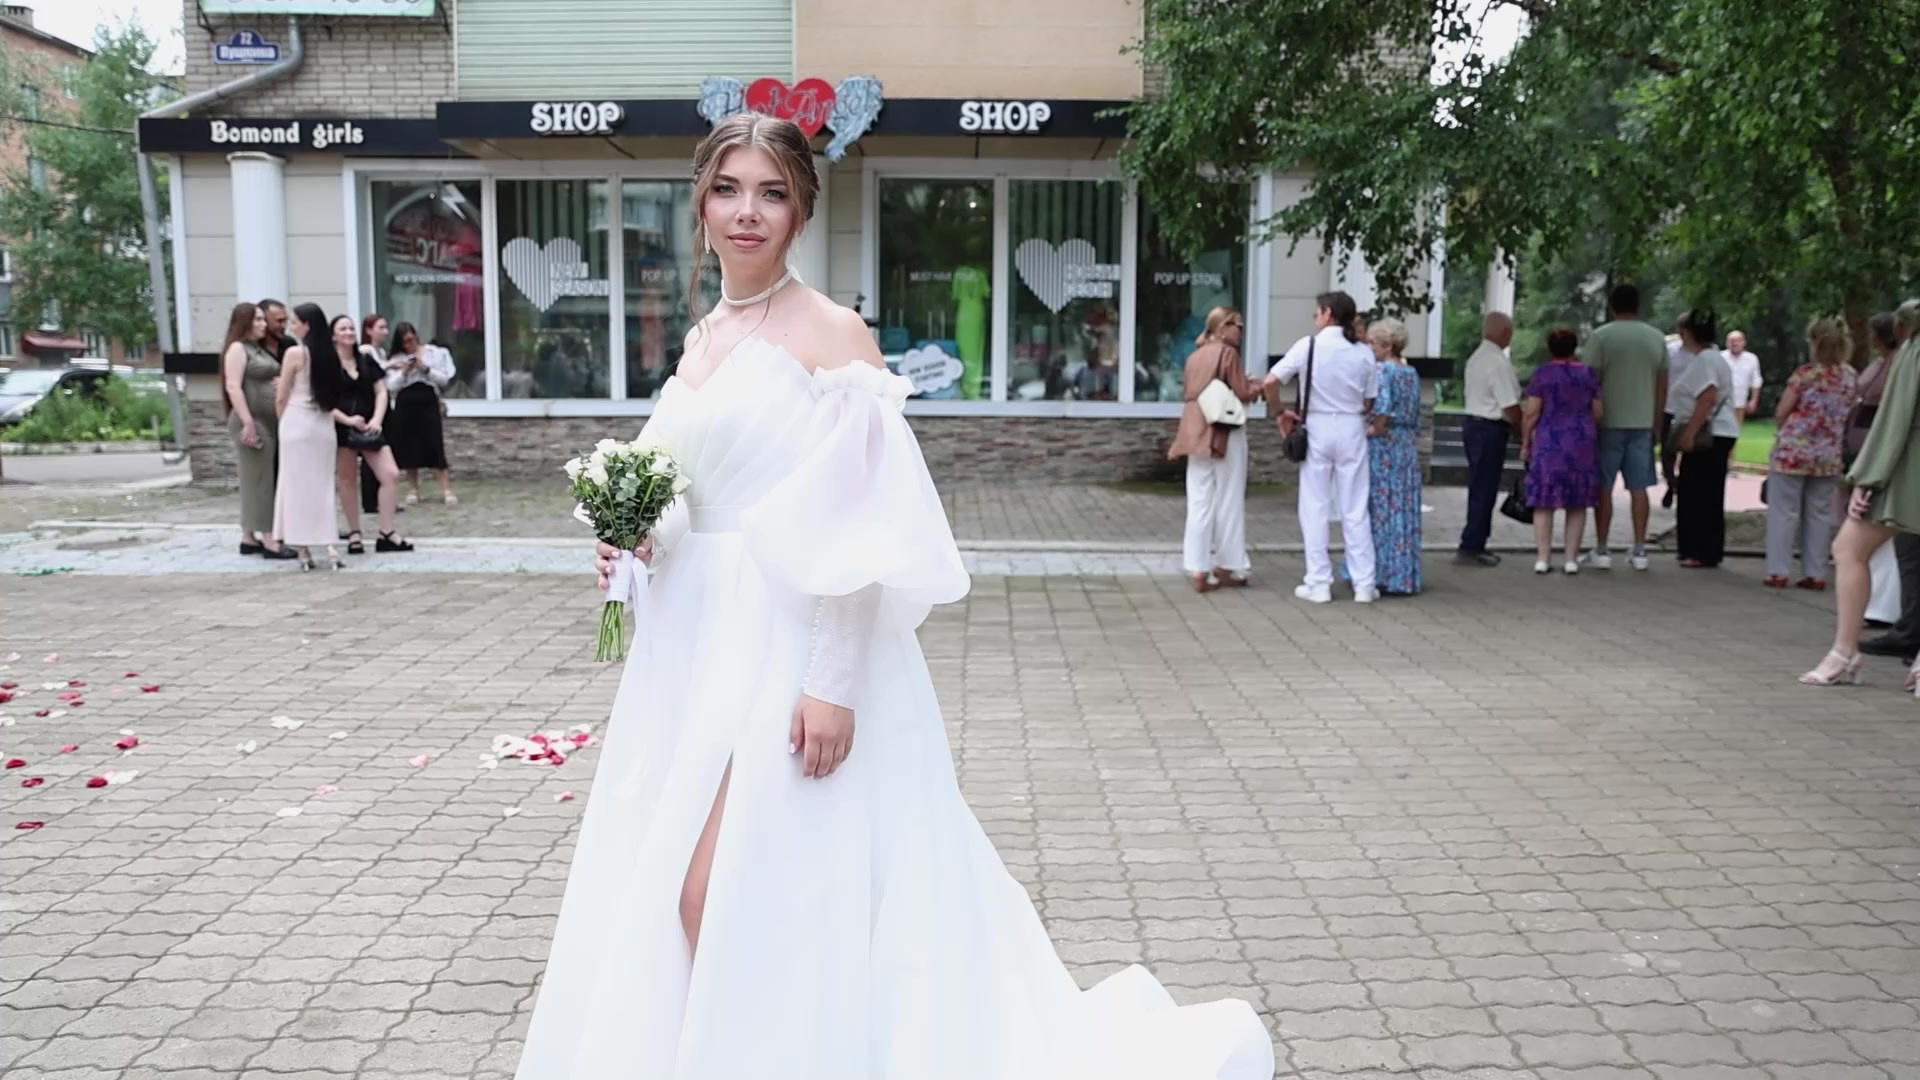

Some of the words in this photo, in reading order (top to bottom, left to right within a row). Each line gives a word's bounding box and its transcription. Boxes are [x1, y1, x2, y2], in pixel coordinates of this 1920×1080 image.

[530, 101, 621, 133] SHOP
[959, 100, 1051, 132] SHOP
[210, 120, 300, 143] Bomond
[312, 121, 364, 149] girls
[641, 269, 662, 282] POP
[1154, 271, 1175, 286] POP
[1175, 271, 1190, 286] UP
